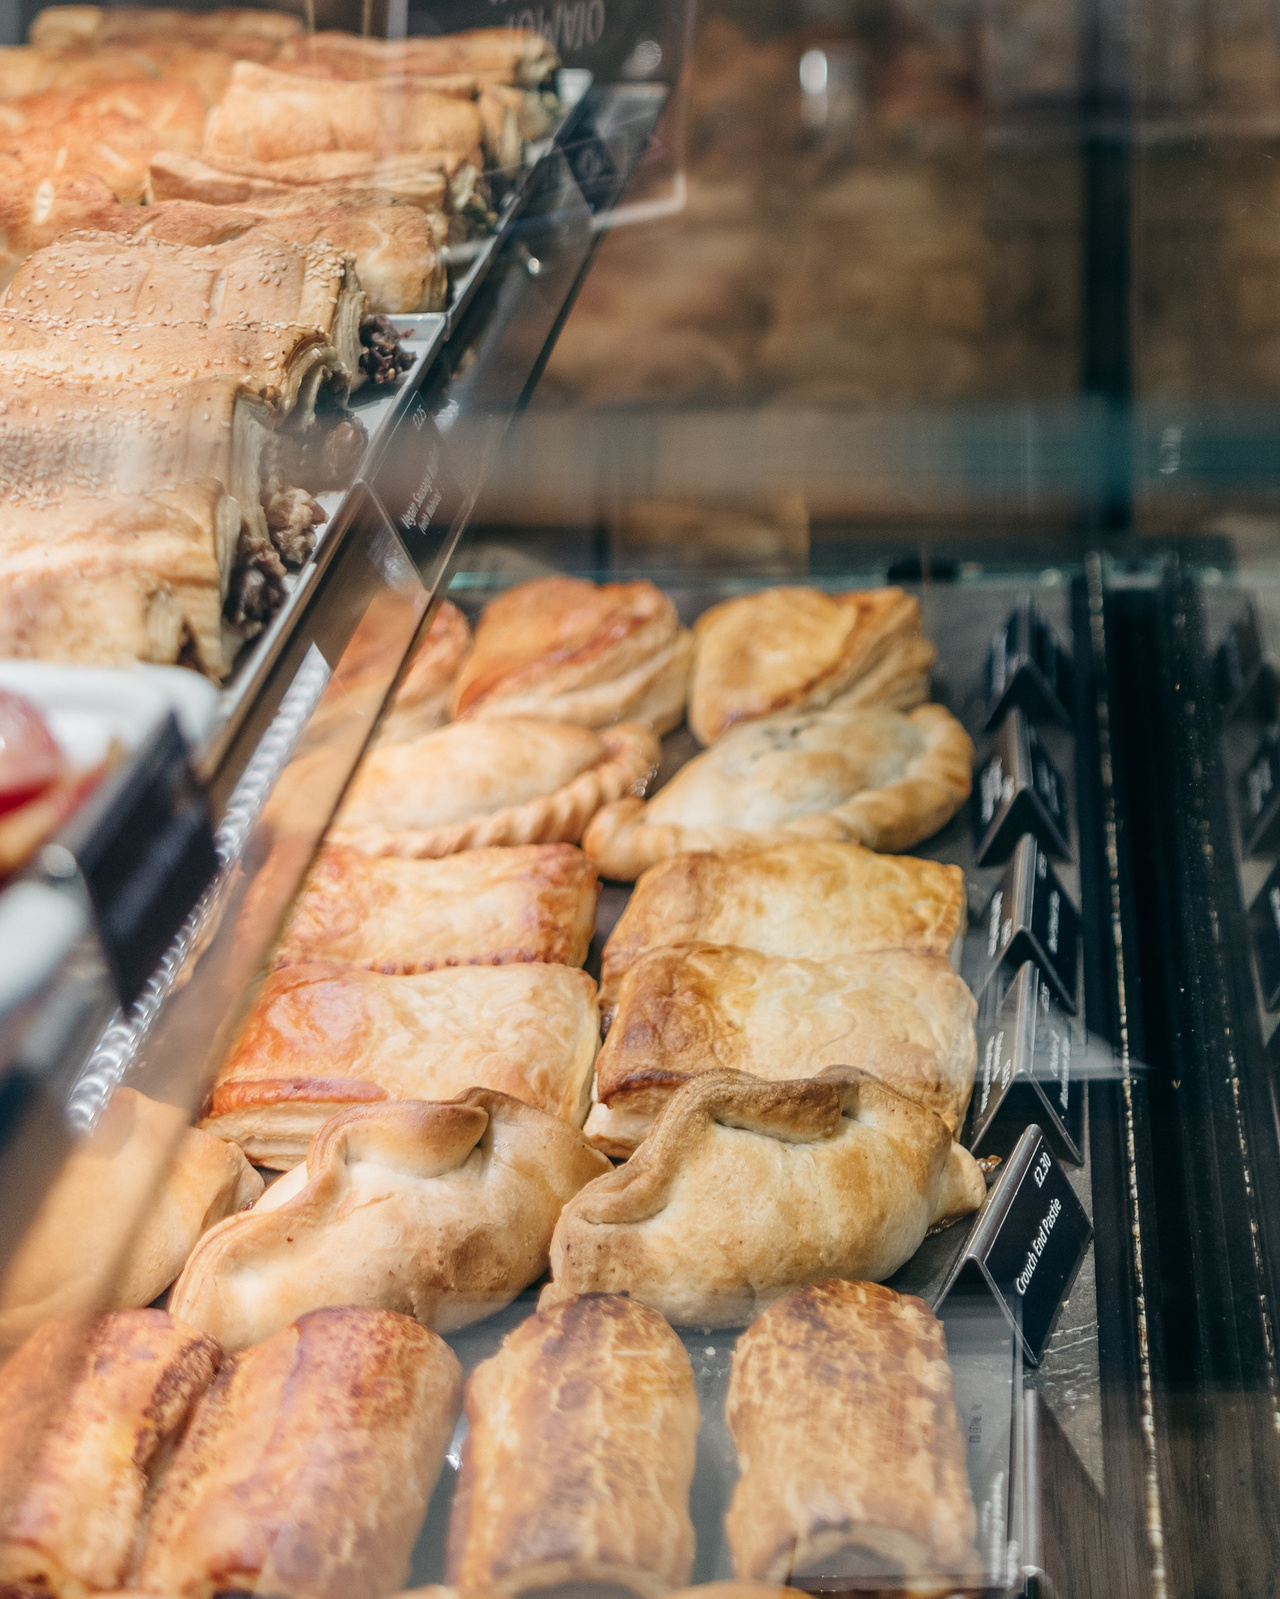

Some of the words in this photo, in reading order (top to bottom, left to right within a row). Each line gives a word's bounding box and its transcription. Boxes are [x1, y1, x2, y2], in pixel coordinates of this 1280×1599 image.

[1033, 1151, 1052, 1188] £2.30
[1016, 1251, 1039, 1296] Crouch
[1032, 1225, 1048, 1258] End
[1042, 1197, 1062, 1235] Pastie
